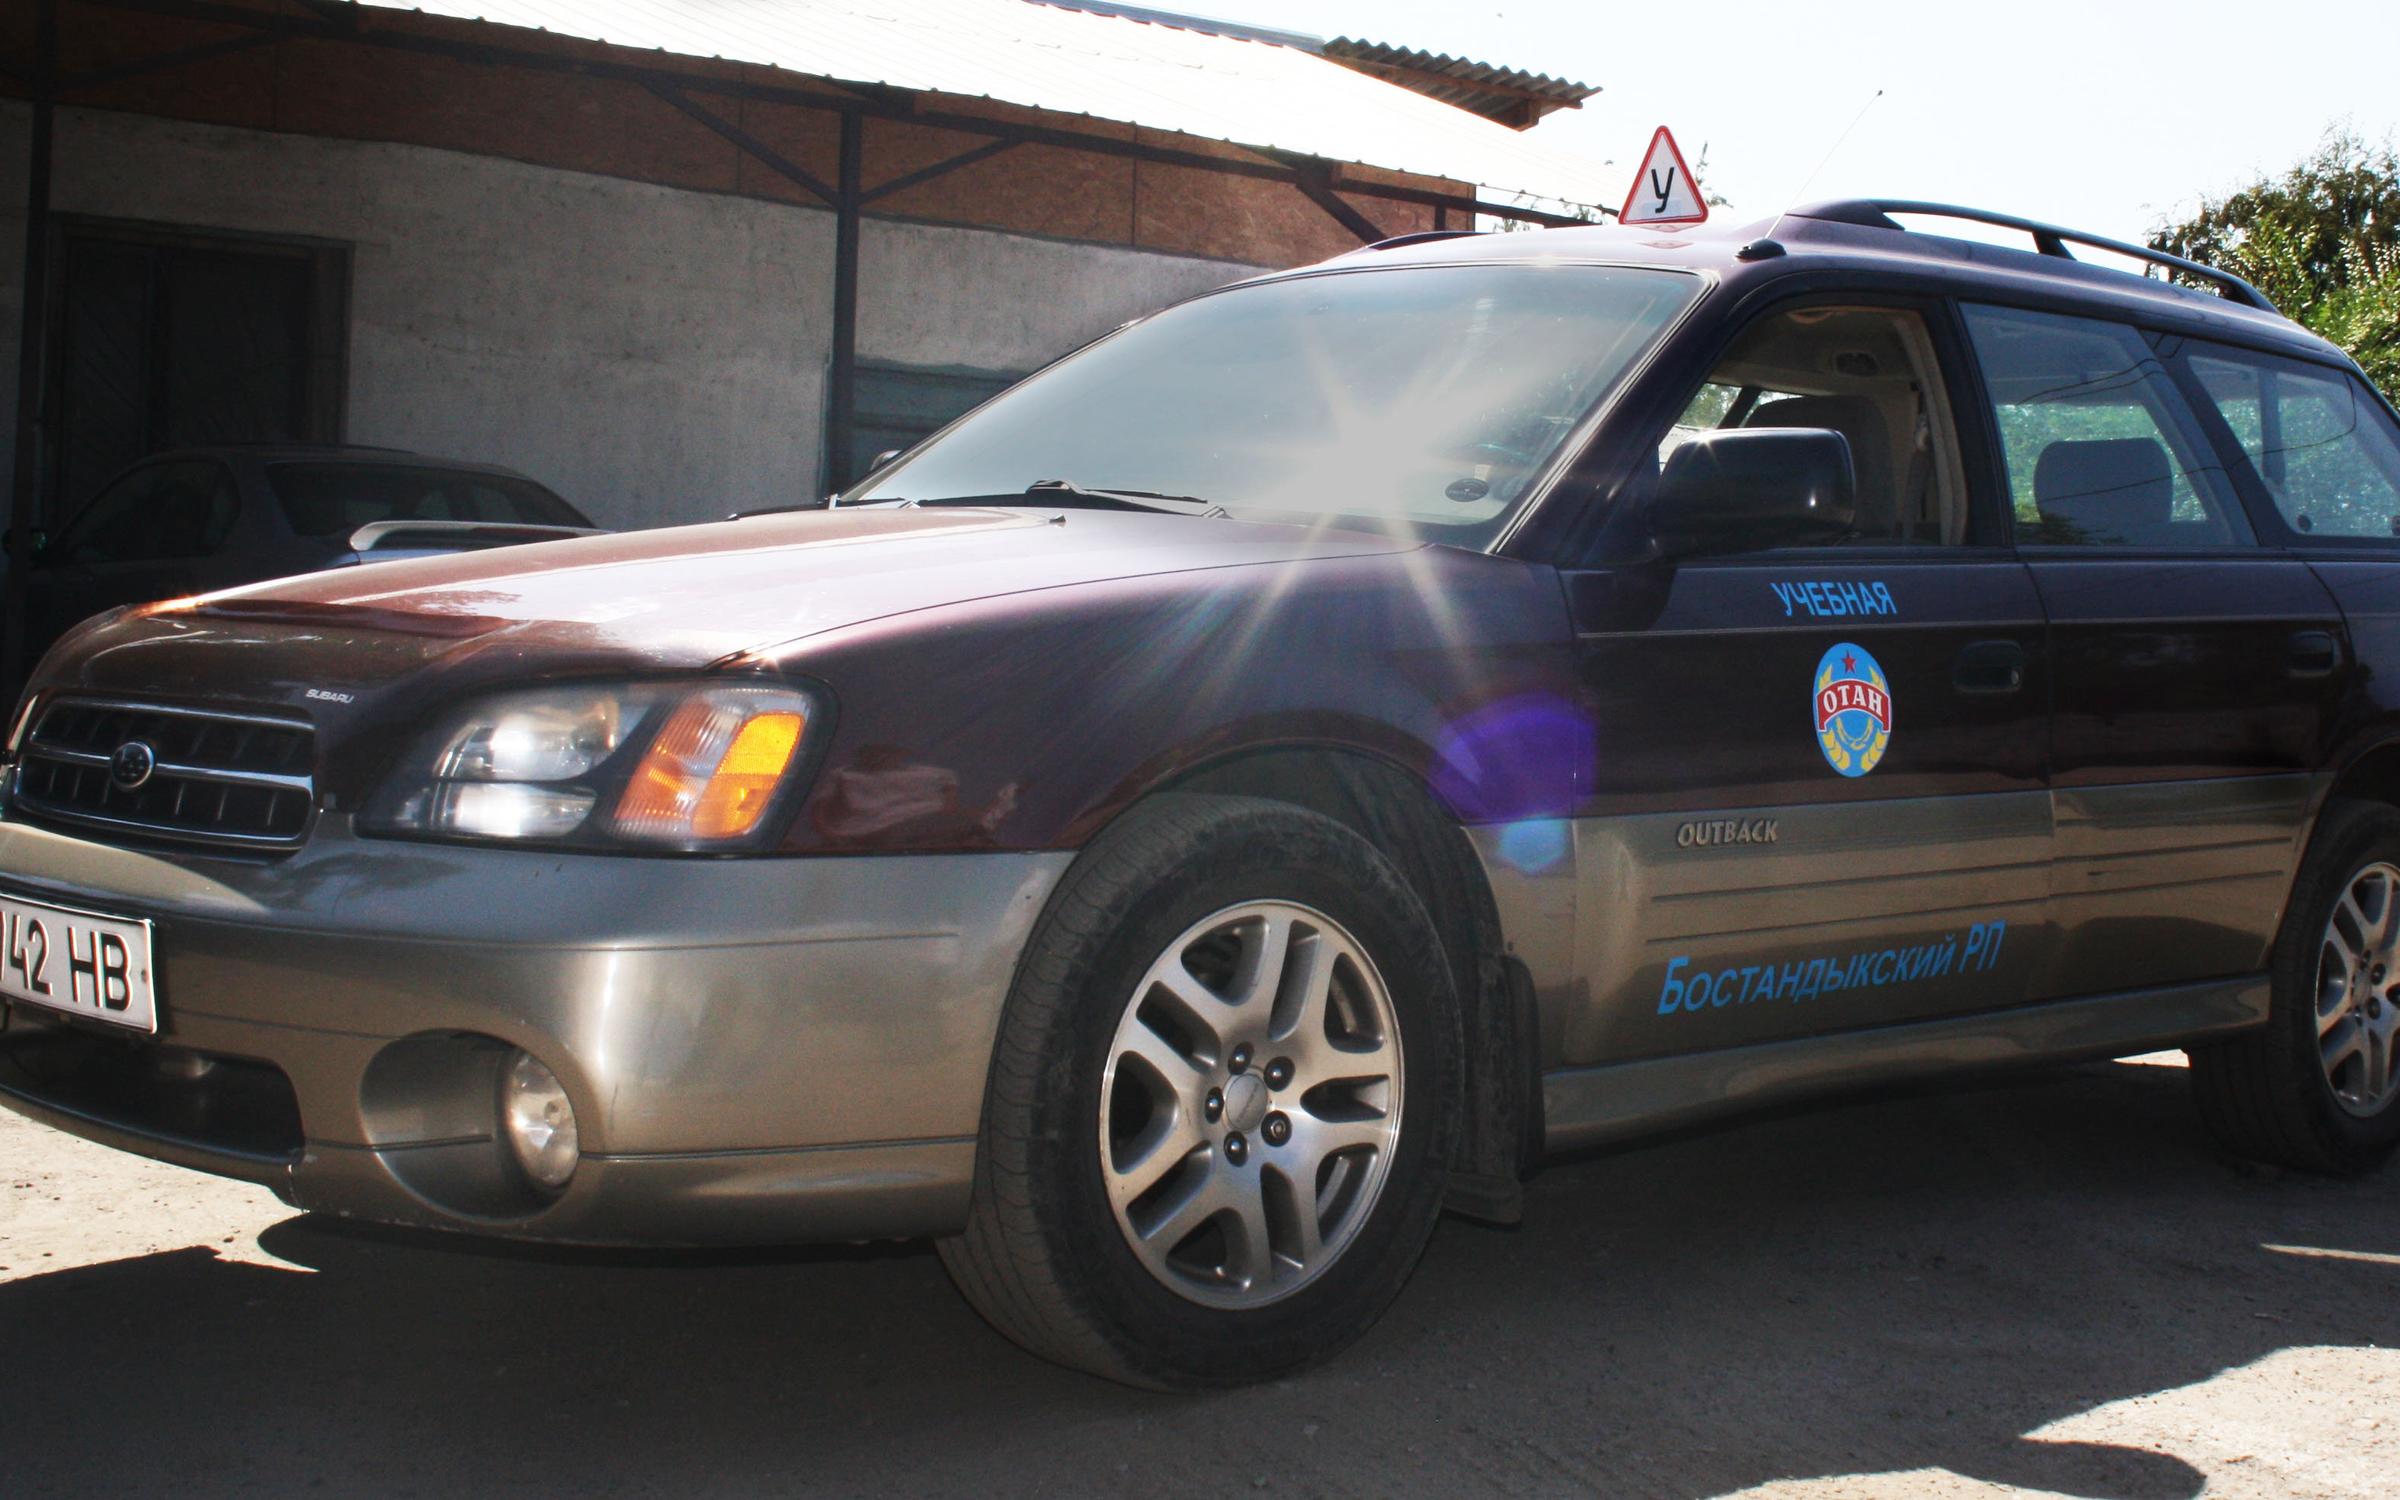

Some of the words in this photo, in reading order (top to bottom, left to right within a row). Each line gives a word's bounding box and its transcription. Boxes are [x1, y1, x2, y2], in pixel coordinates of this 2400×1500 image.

[1769, 581, 1898, 617] УЧЕБНАЯ
[305, 688, 355, 704] SUBARU
[1822, 684, 1884, 717] ОТАН
[1677, 819, 1779, 848] OUTBACK
[0, 911, 53, 997] 42
[68, 926, 134, 1011] HB
[1957, 918, 2007, 974] РП
